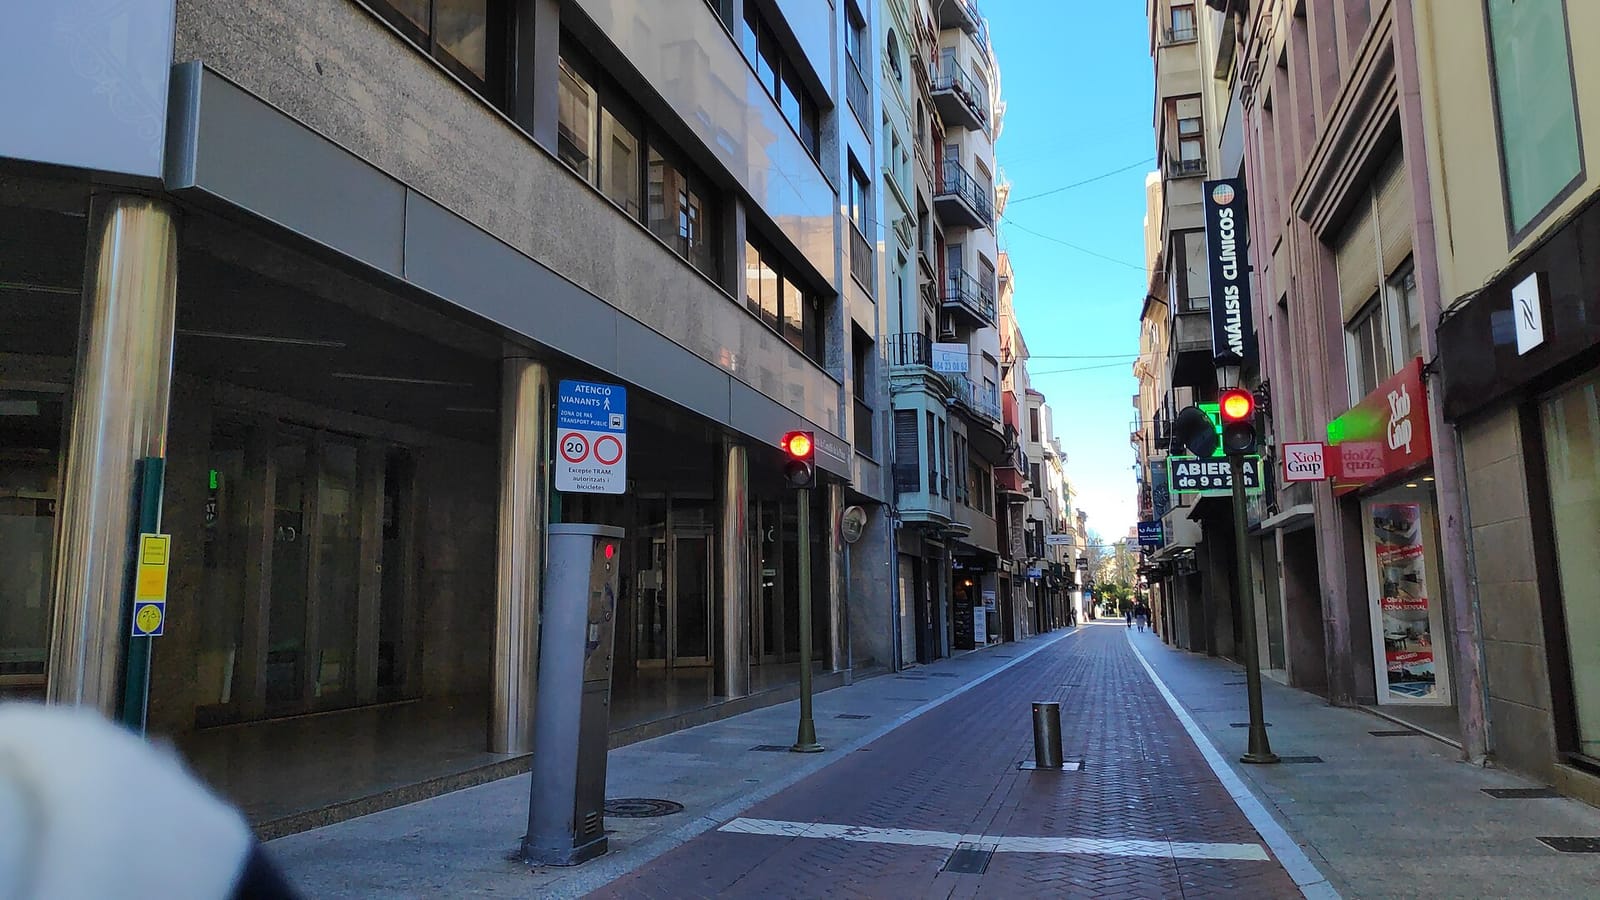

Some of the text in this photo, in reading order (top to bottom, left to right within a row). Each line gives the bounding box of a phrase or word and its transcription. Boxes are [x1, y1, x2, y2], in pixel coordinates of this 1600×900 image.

[1219, 207, 1243, 357] ANÁLISIS CLÍNICOS
[575, 384, 612, 396] ATENCIÓ
[561, 395, 600, 407] VIANANTS
[561, 410, 575, 418] ZONA
[561, 417, 590, 426] TRANSPORT
[566, 442, 583, 453] 20
[1293, 451, 1321, 463] Xiob
[568, 467, 592, 475] Excepte
[1176, 461, 1254, 476] ABIERA
[1288, 461, 1321, 474] Grup
[1178, 476, 1196, 487] de
[1200, 475, 1209, 486] 9
[1213, 478, 1222, 486] a
